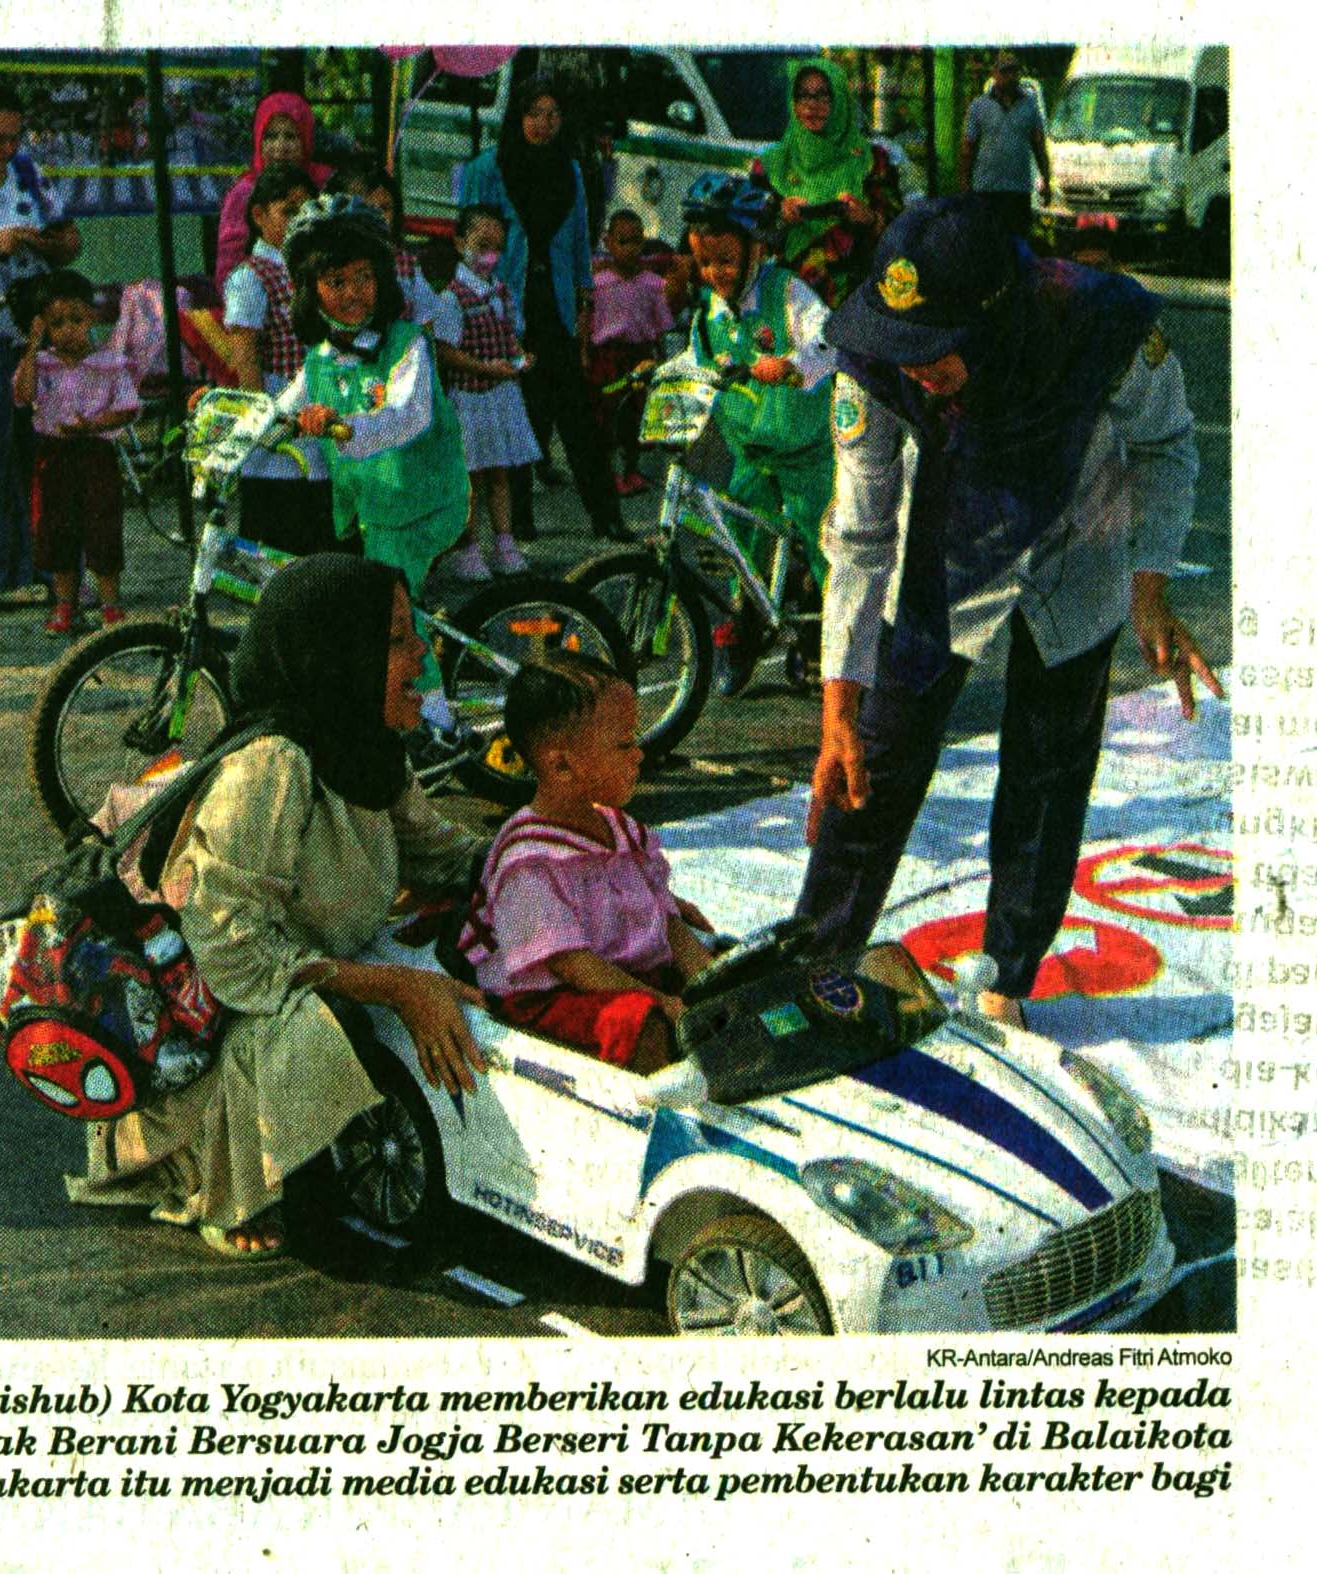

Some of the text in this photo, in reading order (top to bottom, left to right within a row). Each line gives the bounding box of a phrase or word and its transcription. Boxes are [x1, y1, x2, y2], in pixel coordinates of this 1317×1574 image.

[927, 1348, 1233, 1367] KR-Antara/Andreas Fitri Atmoko
[123, 1385, 209, 1413] Kota
[221, 1382, 429, 1419] Yogyakarta
[440, 1382, 668, 1411] memberikan
[680, 1381, 823, 1410] edukasi
[835, 1380, 967, 1411] berlalu
[980, 1380, 1084, 1408] lintas
[1095, 1378, 1231, 1415] kepada
[48, 1426, 176, 1455] Berani
[189, 1426, 365, 1455] Bersuara
[377, 1425, 483, 1460] Jogja
[494, 1424, 628, 1453] Berseri
[643, 1424, 761, 1459] Tanpa
[992, 1422, 1030, 1450] di
[1042, 1420, 1231, 1449] Balaikota
[121, 1469, 170, 1496] itu
[182, 1467, 331, 1503] menjadi
[343, 1467, 455, 1495] media
[465, 1466, 608, 1495] edukasi
[618, 1468, 709, 1494] serta
[715, 1464, 969, 1500] pembentukan
[979, 1463, 1143, 1491] karakter
[1152, 1462, 1231, 1497] bagi
